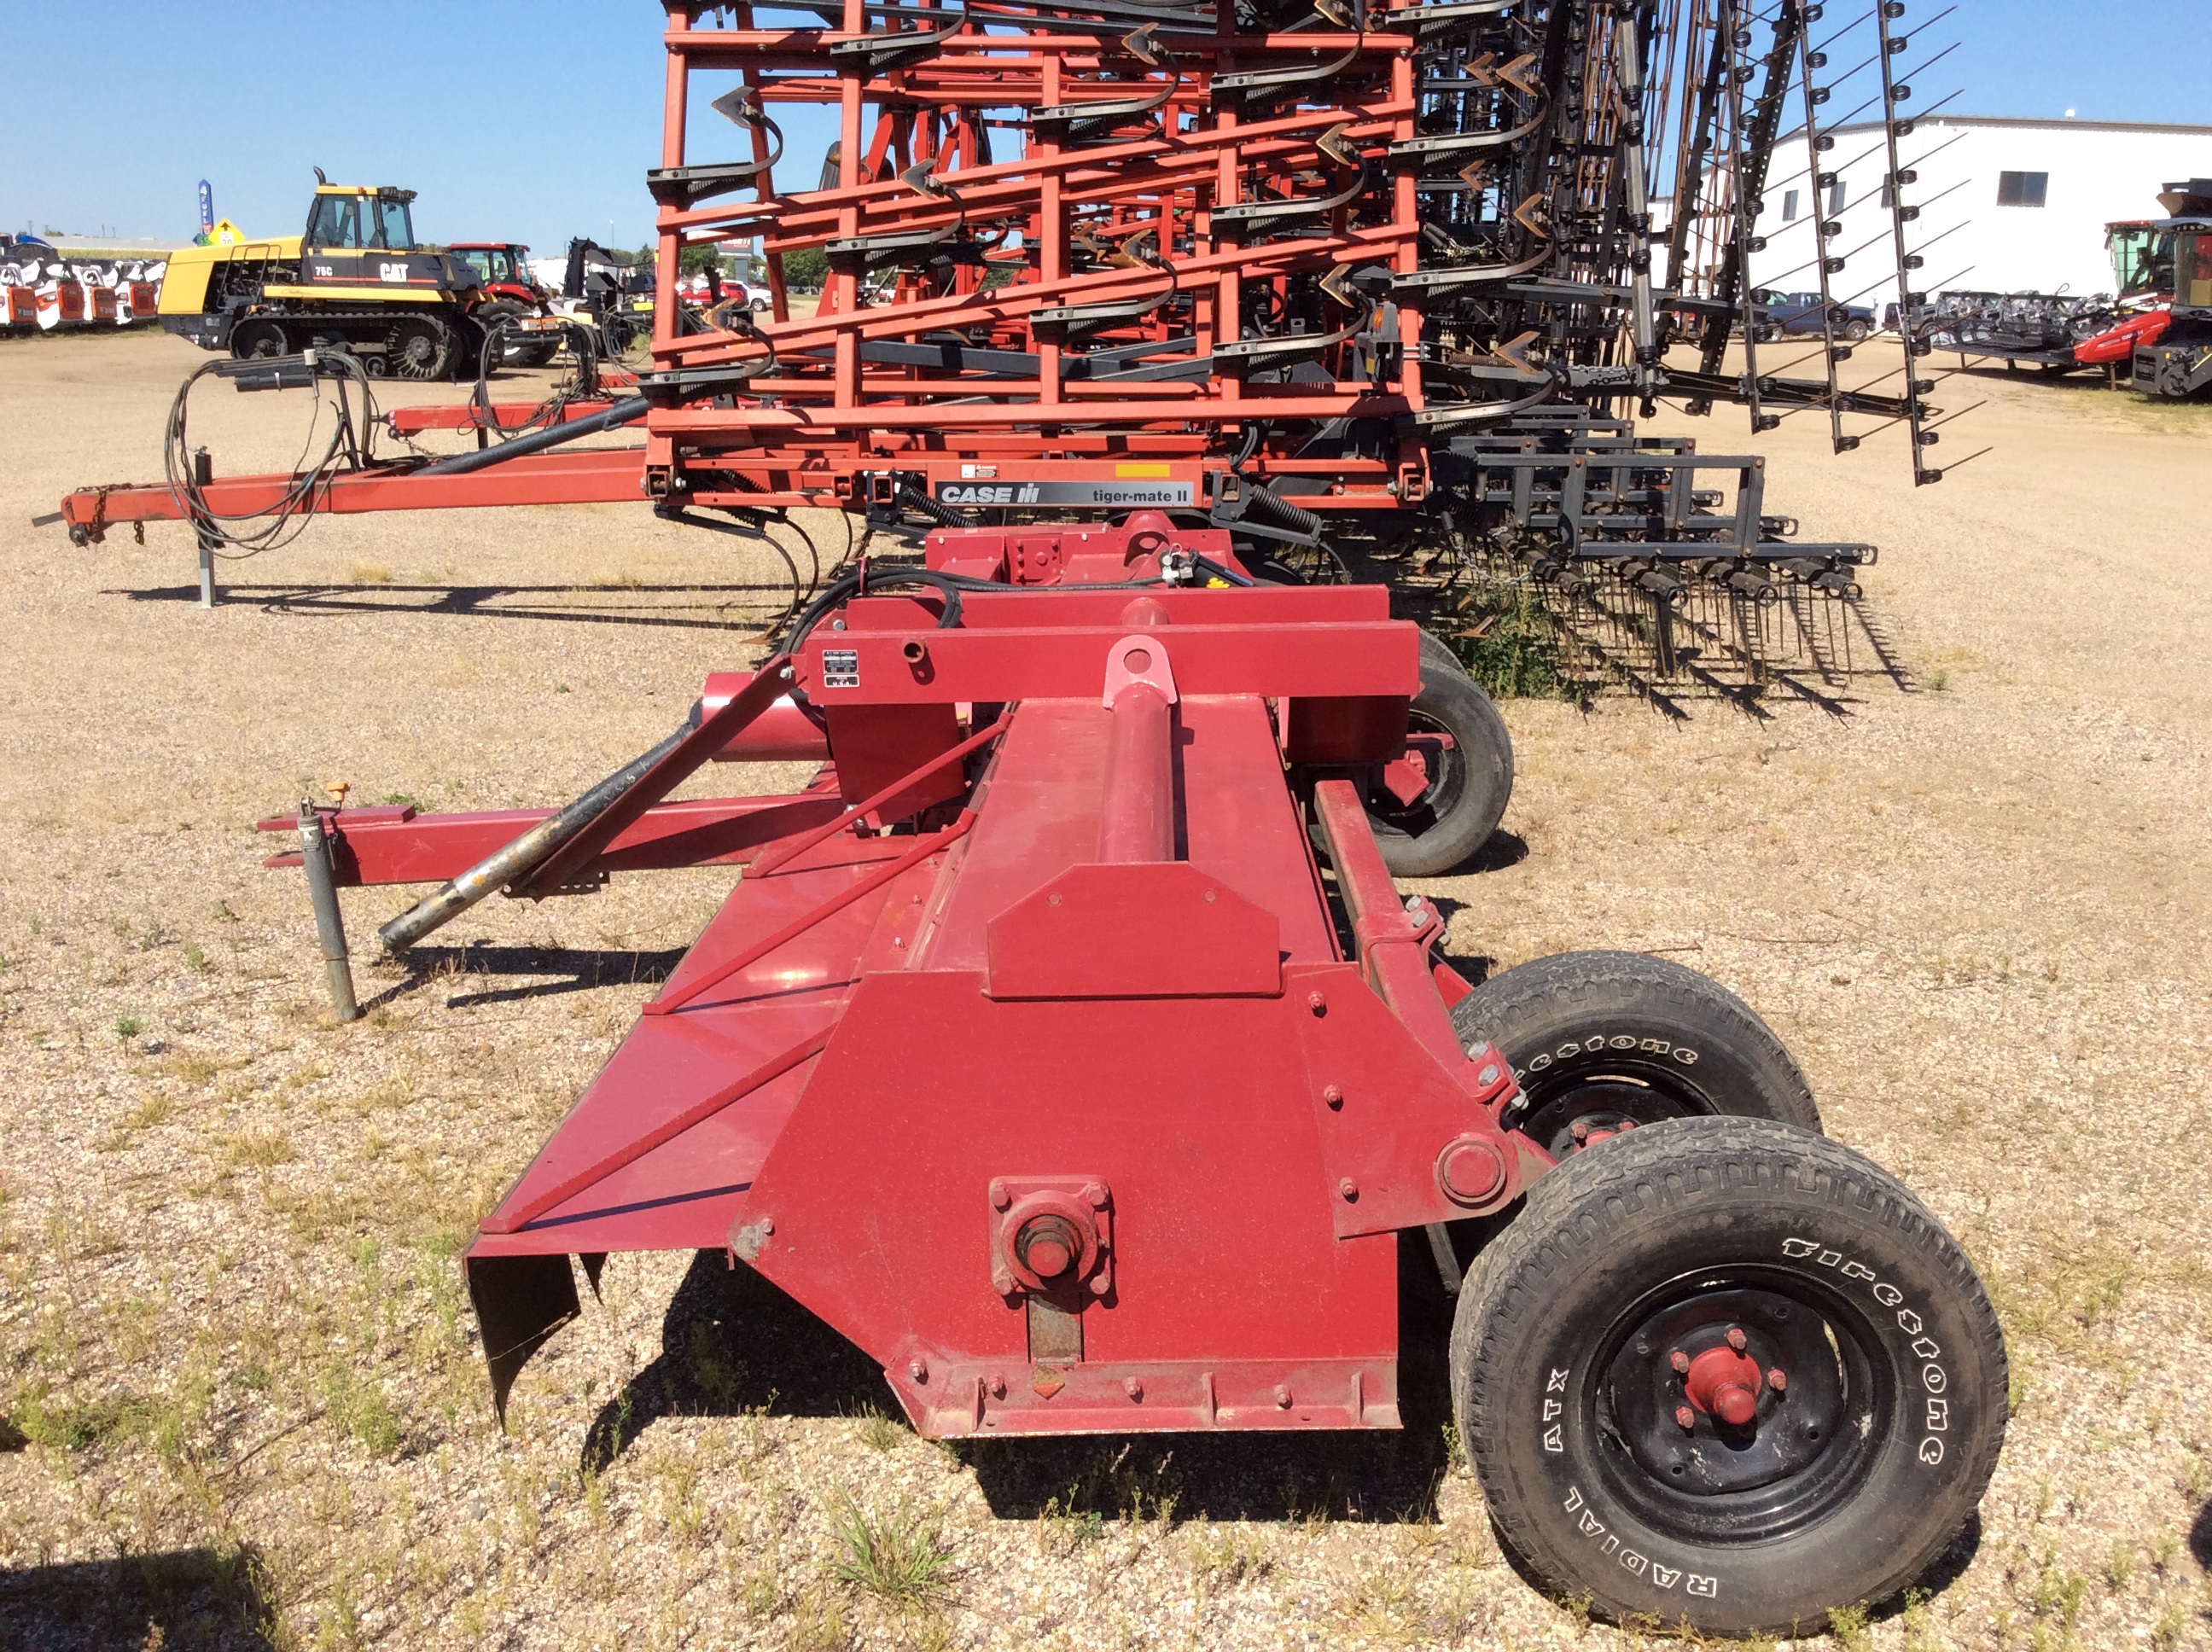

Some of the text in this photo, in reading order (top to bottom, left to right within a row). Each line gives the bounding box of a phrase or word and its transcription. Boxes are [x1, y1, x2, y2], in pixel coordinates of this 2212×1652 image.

[315, 266, 333, 276] 75C
[380, 263, 409, 282] CAT
[941, 486, 1013, 503] CASE
[1093, 490, 1187, 504] tiger-mate II
[1782, 1238, 1948, 1465] Firestone
[1543, 1368, 1569, 1452] ATX
[1563, 1486, 1717, 1598] RADIAL
